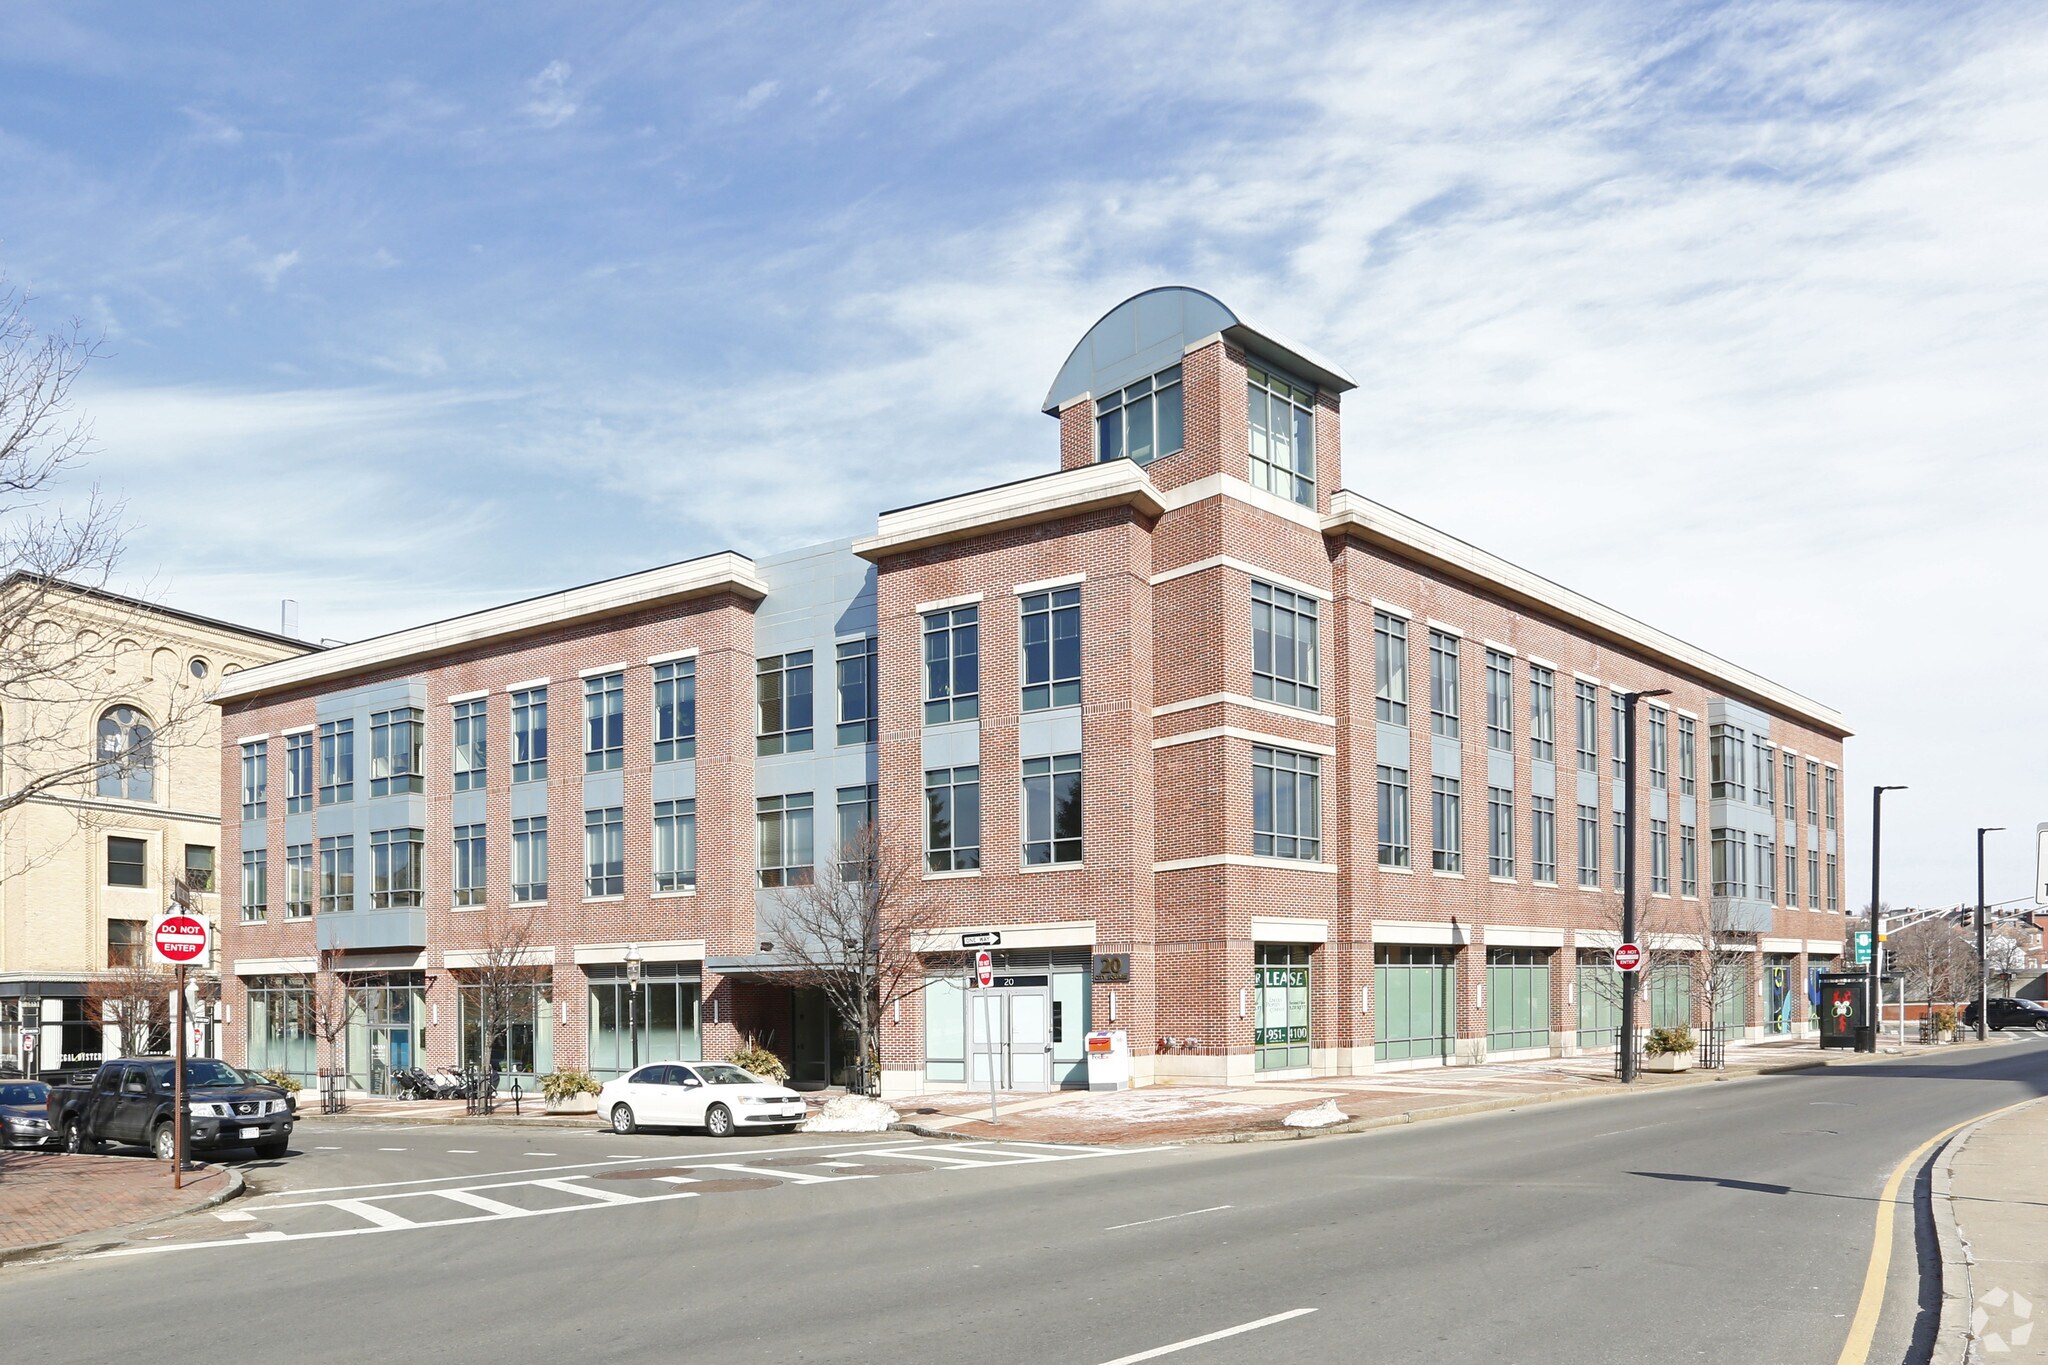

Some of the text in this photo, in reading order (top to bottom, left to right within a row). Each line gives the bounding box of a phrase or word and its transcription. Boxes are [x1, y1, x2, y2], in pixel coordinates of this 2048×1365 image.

[161, 925, 200, 934] DO NOT
[164, 944, 196, 952] ENTER
[1100, 957, 1121, 973] 20
[1003, 978, 1014, 986] 20
[1267, 972, 1303, 986] LEASE
